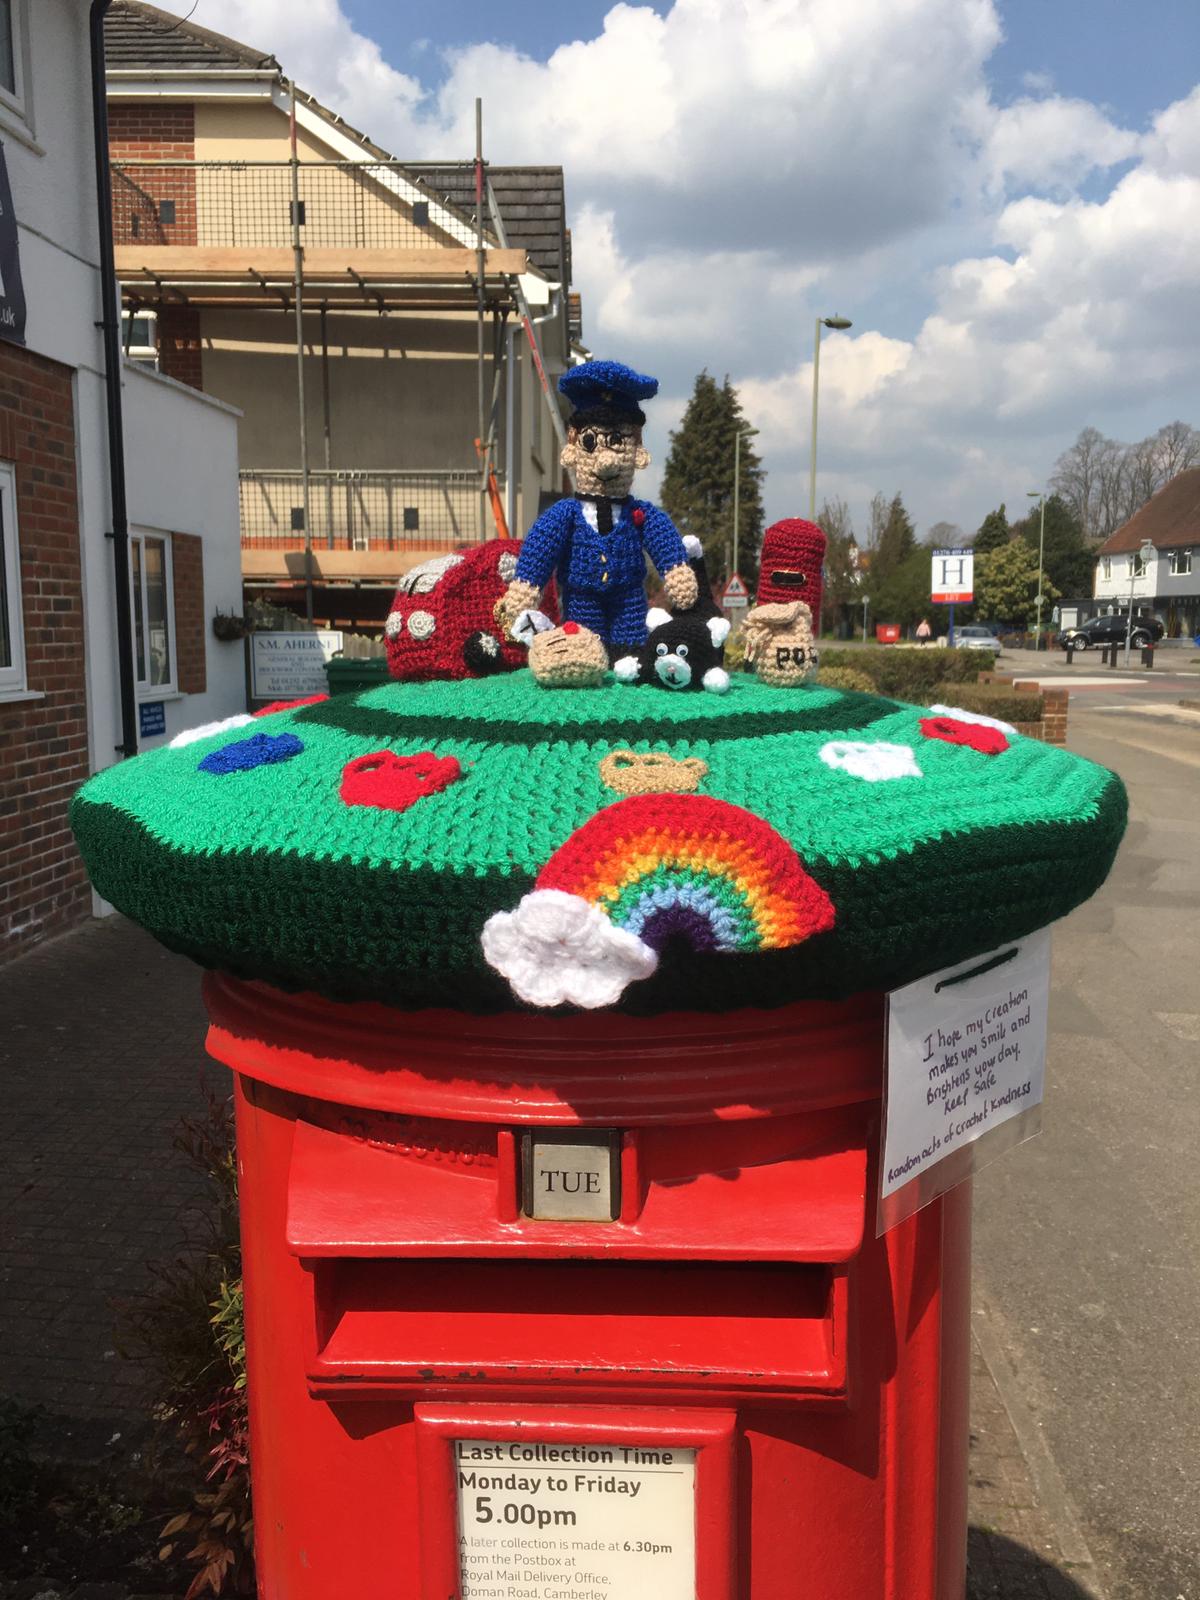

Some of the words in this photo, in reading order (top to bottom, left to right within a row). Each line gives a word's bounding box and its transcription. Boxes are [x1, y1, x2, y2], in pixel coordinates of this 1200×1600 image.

[939, 558, 967, 585] H
[923, 1033, 934, 1063] I
[937, 1028, 962, 1048] hope
[966, 1019, 983, 1036] my
[928, 1052, 959, 1080] makes
[961, 1044, 978, 1063] you
[1010, 1005, 1031, 1033] and
[974, 1056, 996, 1078] your
[921, 1136, 941, 1159] acts
[944, 1122, 954, 1144] of
[540, 1170, 601, 1194] TUE
[457, 1442, 504, 1461] Last
[509, 1443, 613, 1464] Collection
[618, 1446, 673, 1466] Time
[459, 1471, 542, 1494] Monday
[547, 1476, 568, 1492] to
[574, 1475, 642, 1498] Friday
[475, 1496, 577, 1529] 5.00pm
[460, 1535, 468, 1546] A
[470, 1536, 498, 1547] later
[500, 1537, 557, 1549] collection
[559, 1538, 569, 1550] is
[571, 1540, 606, 1551] made
[608, 1541, 621, 1551] at
[623, 1540, 672, 1555] 6.30pm
[460, 1553, 489, 1564] from
[492, 1554, 511, 1565] the
[514, 1554, 561, 1566] Postbox
[564, 1557, 576, 1567] at
[461, 1568, 493, 1583] Royal
[496, 1570, 521, 1581] Mail
[524, 1570, 572, 1585] Delivery
[462, 1585, 505, 1597] Doman
[544, 1587, 608, 1600] Camberley
